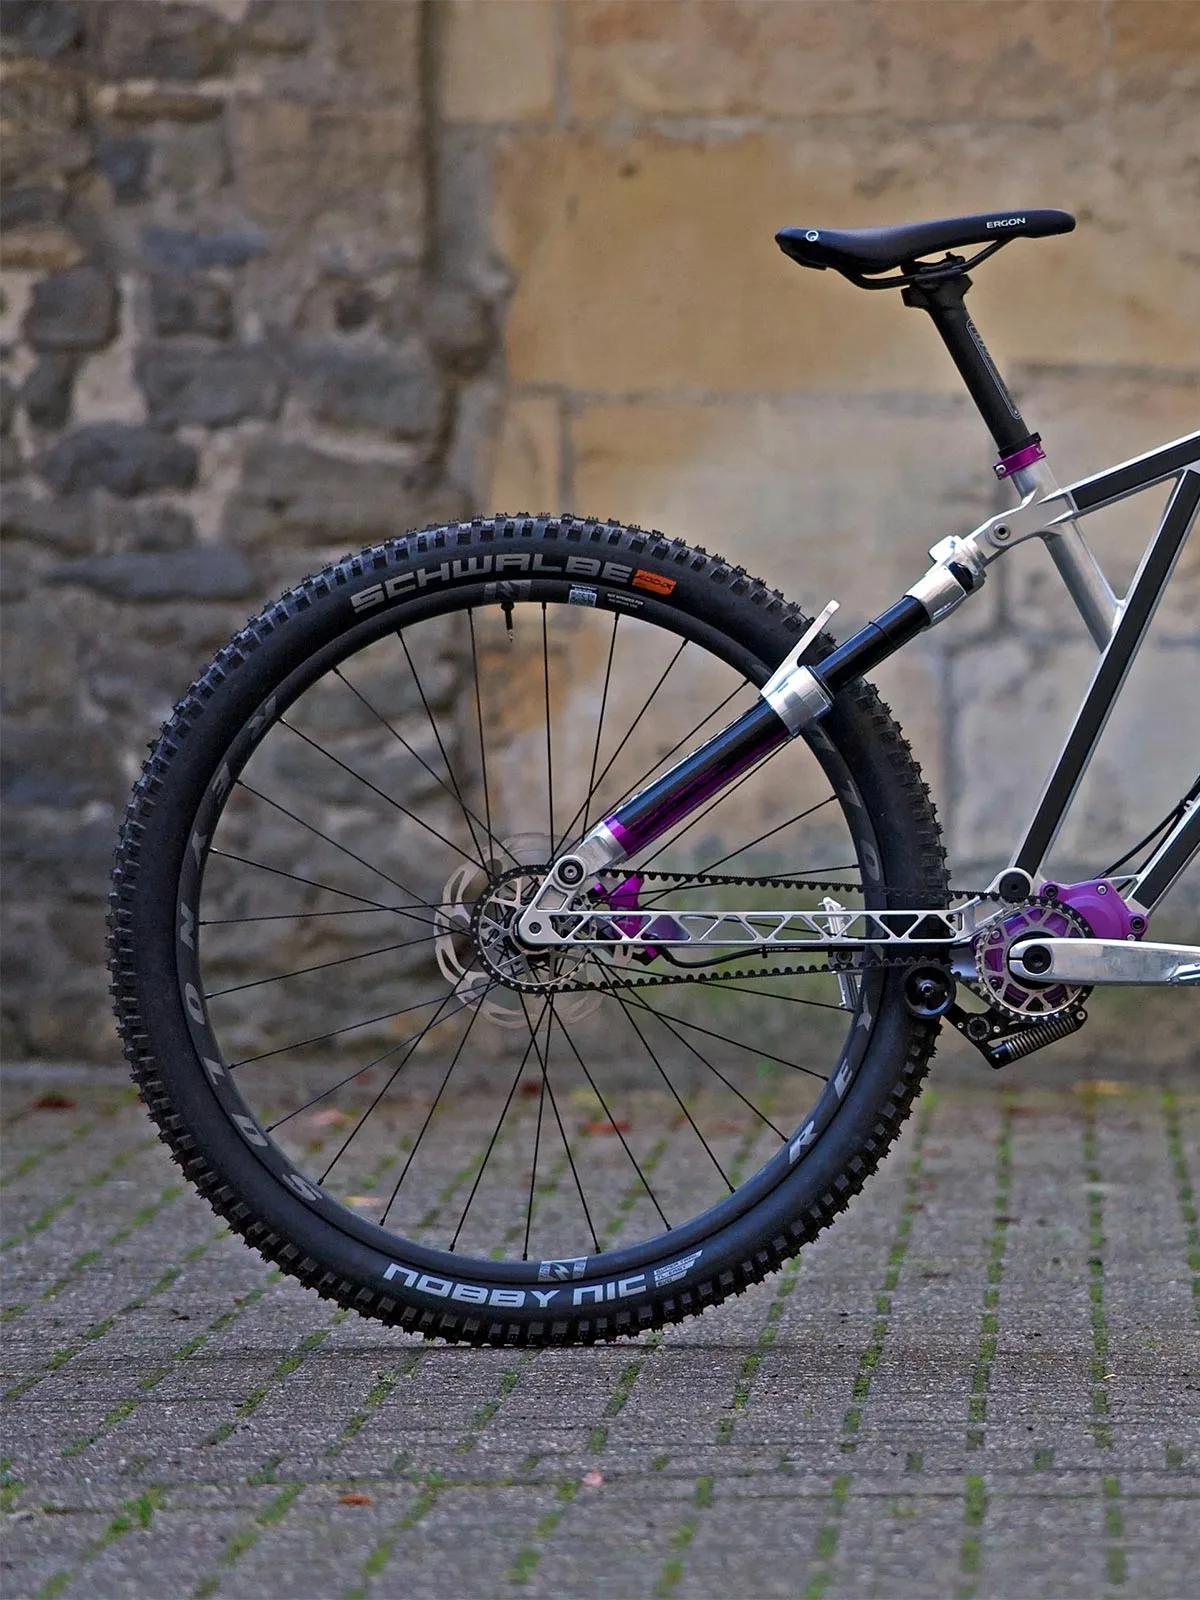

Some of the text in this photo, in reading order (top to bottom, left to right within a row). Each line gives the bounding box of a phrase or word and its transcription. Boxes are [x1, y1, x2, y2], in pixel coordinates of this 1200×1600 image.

[986, 217, 1026, 229] ERGON
[350, 552, 634, 614] SCHWALBE
[180, 695, 323, 1202] REYNOLDS
[383, 1263, 561, 1309] NOBBY
[572, 1273, 647, 1306] NIC
